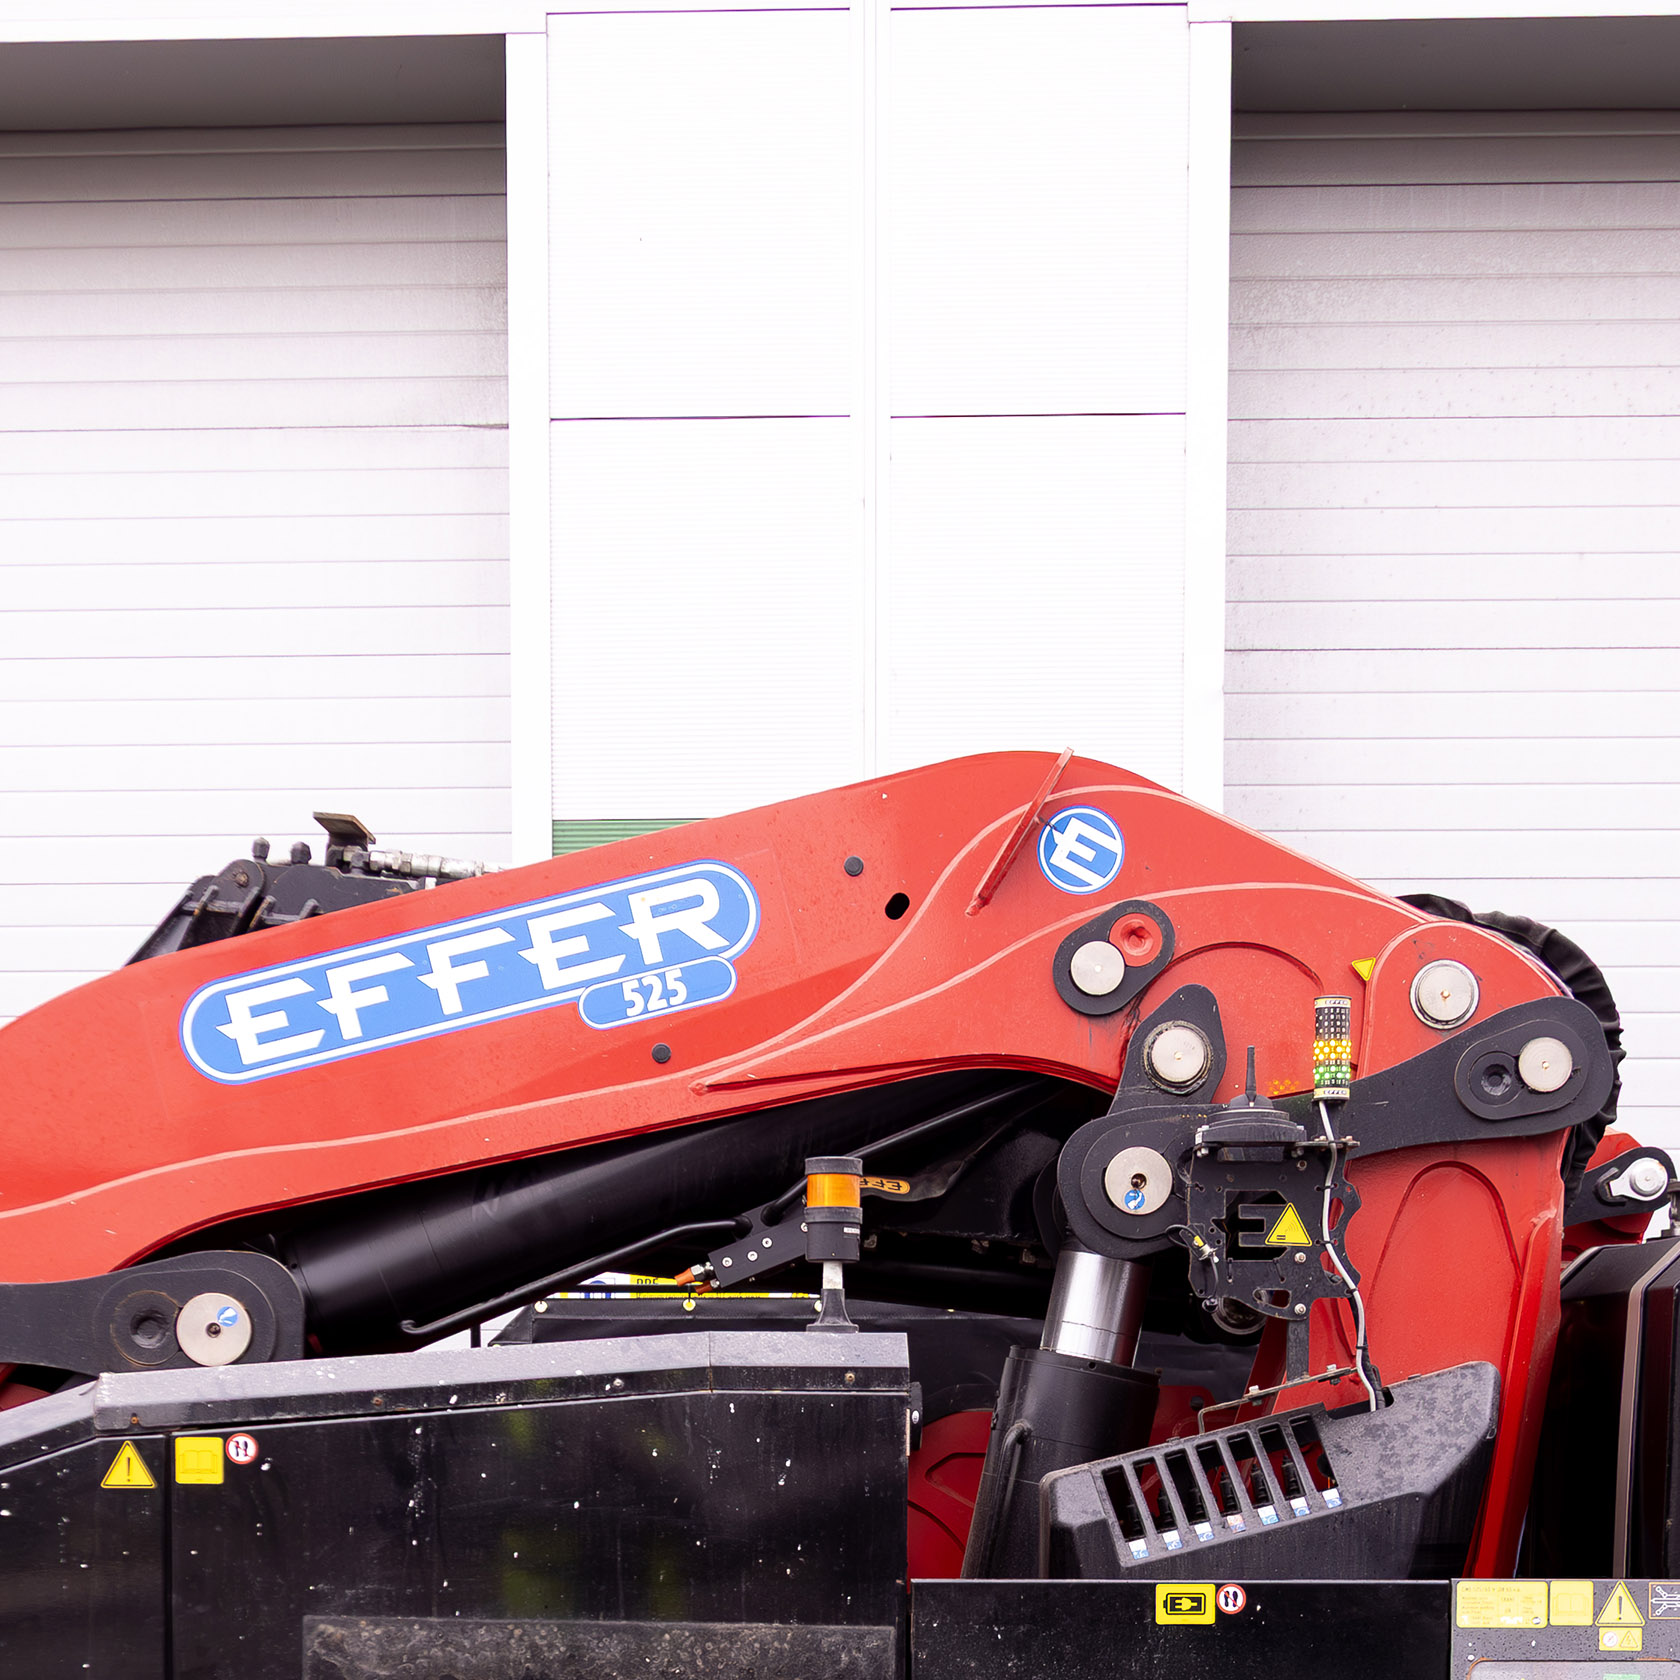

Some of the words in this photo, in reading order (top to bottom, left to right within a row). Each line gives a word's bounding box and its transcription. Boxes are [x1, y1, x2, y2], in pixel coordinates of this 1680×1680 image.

[1047, 816, 1123, 891] E
[216, 878, 730, 1065] EFFER
[622, 968, 687, 1017] 525
